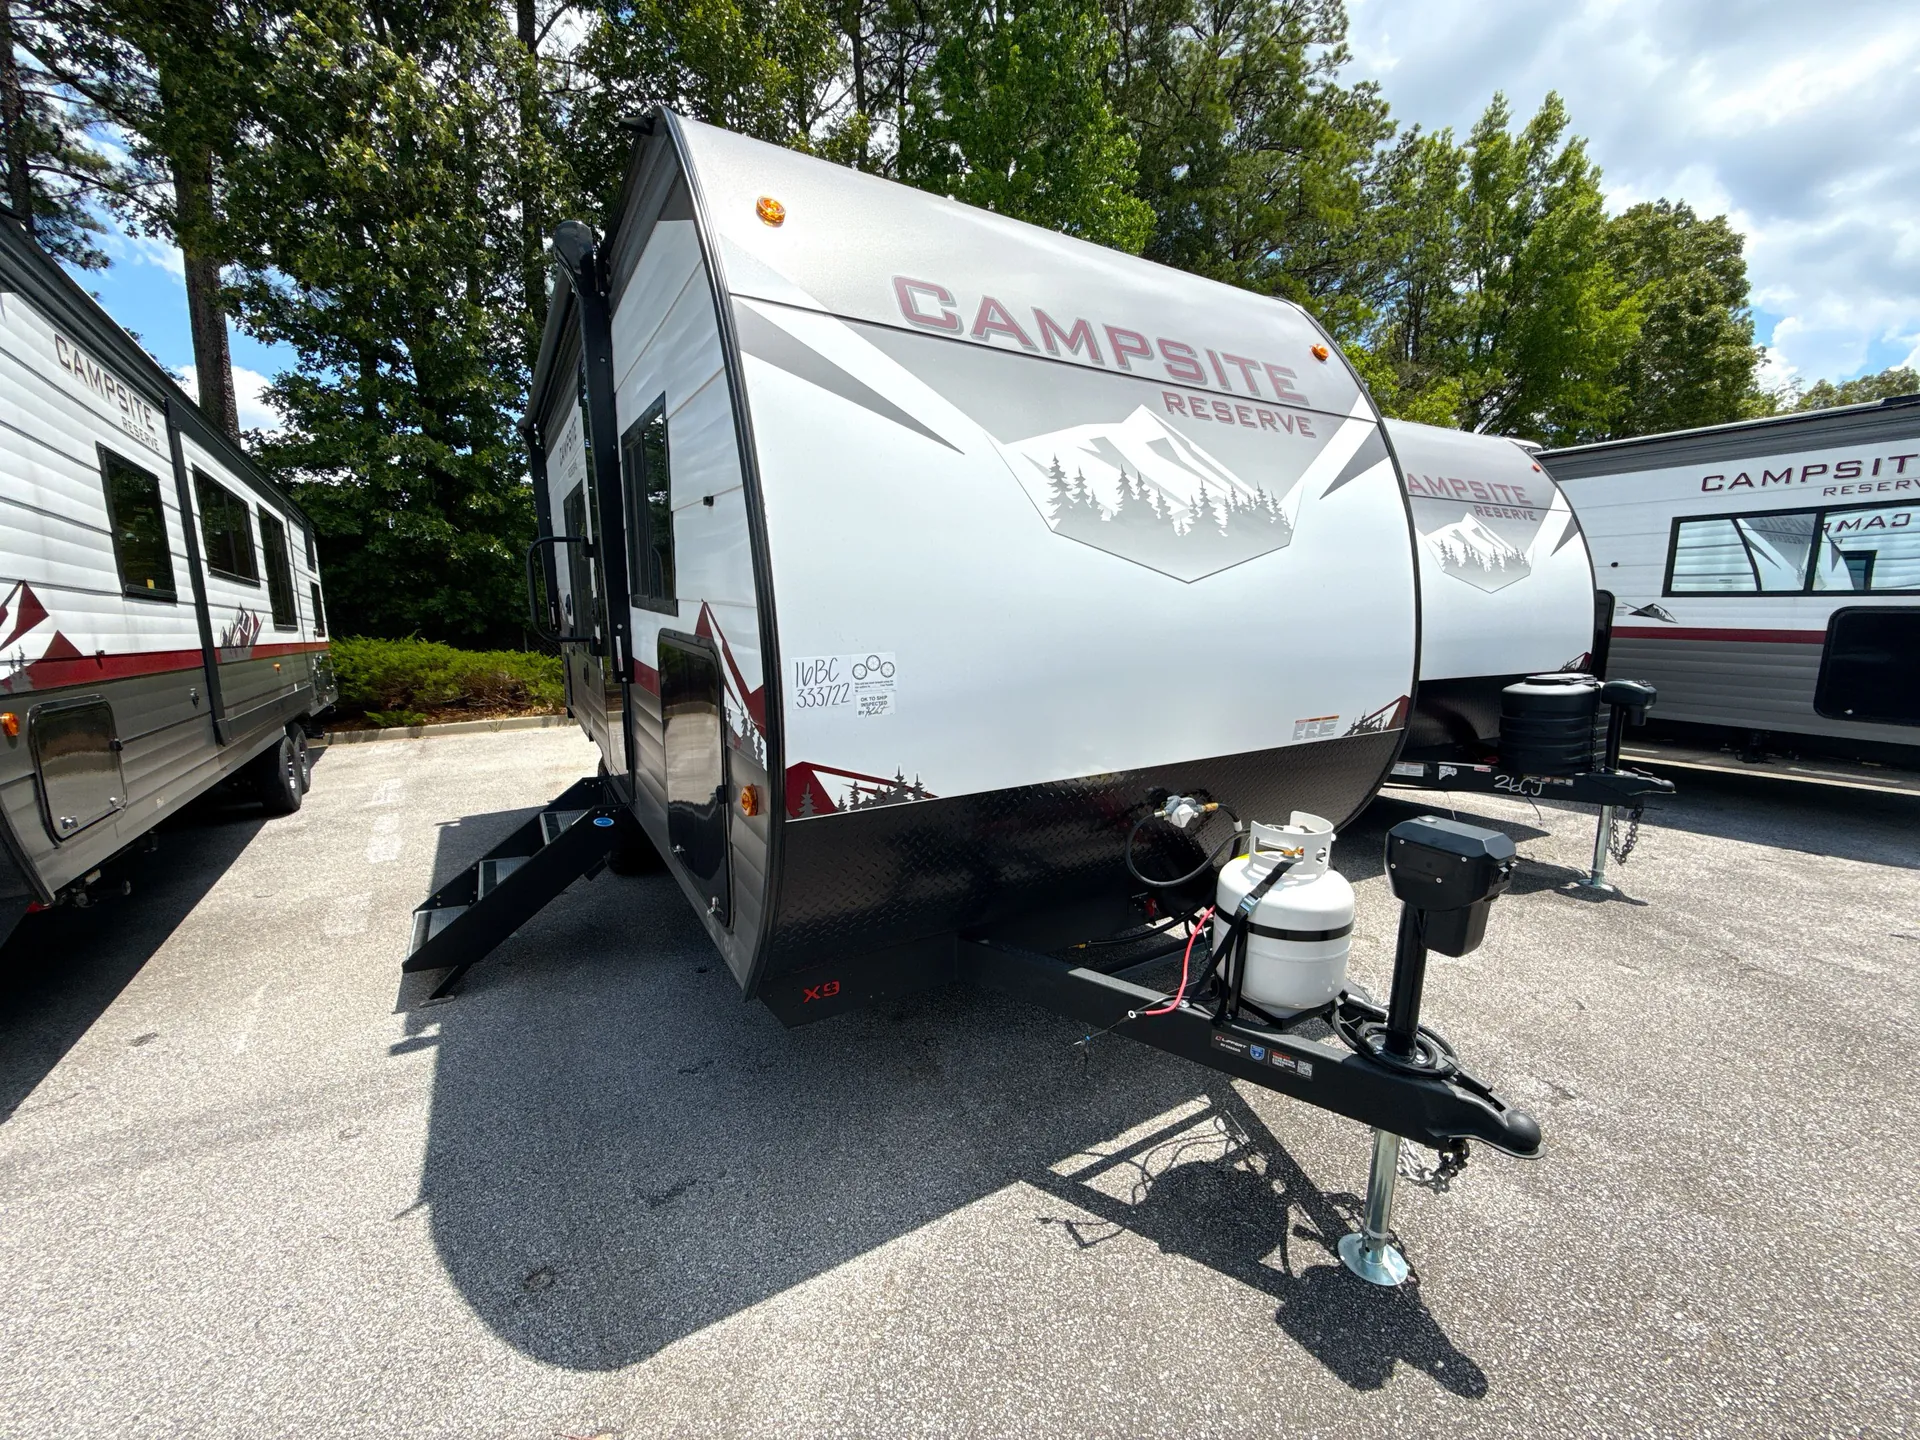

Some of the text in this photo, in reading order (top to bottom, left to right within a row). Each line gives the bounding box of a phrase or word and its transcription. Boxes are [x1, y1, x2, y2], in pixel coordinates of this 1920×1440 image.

[892, 275, 1309, 406] CAMPSITE
[55, 333, 156, 434] CAMPSITE
[1161, 391, 1318, 438] RESERVE
[121, 415, 160, 451] RESERVE
[1407, 473, 1533, 506] AMPSITE
[1701, 453, 1920, 493] CAMPSIT
[1473, 505, 1538, 522] RESERVE
[795, 657, 840, 688] 16BC
[796, 682, 851, 708] 333722
